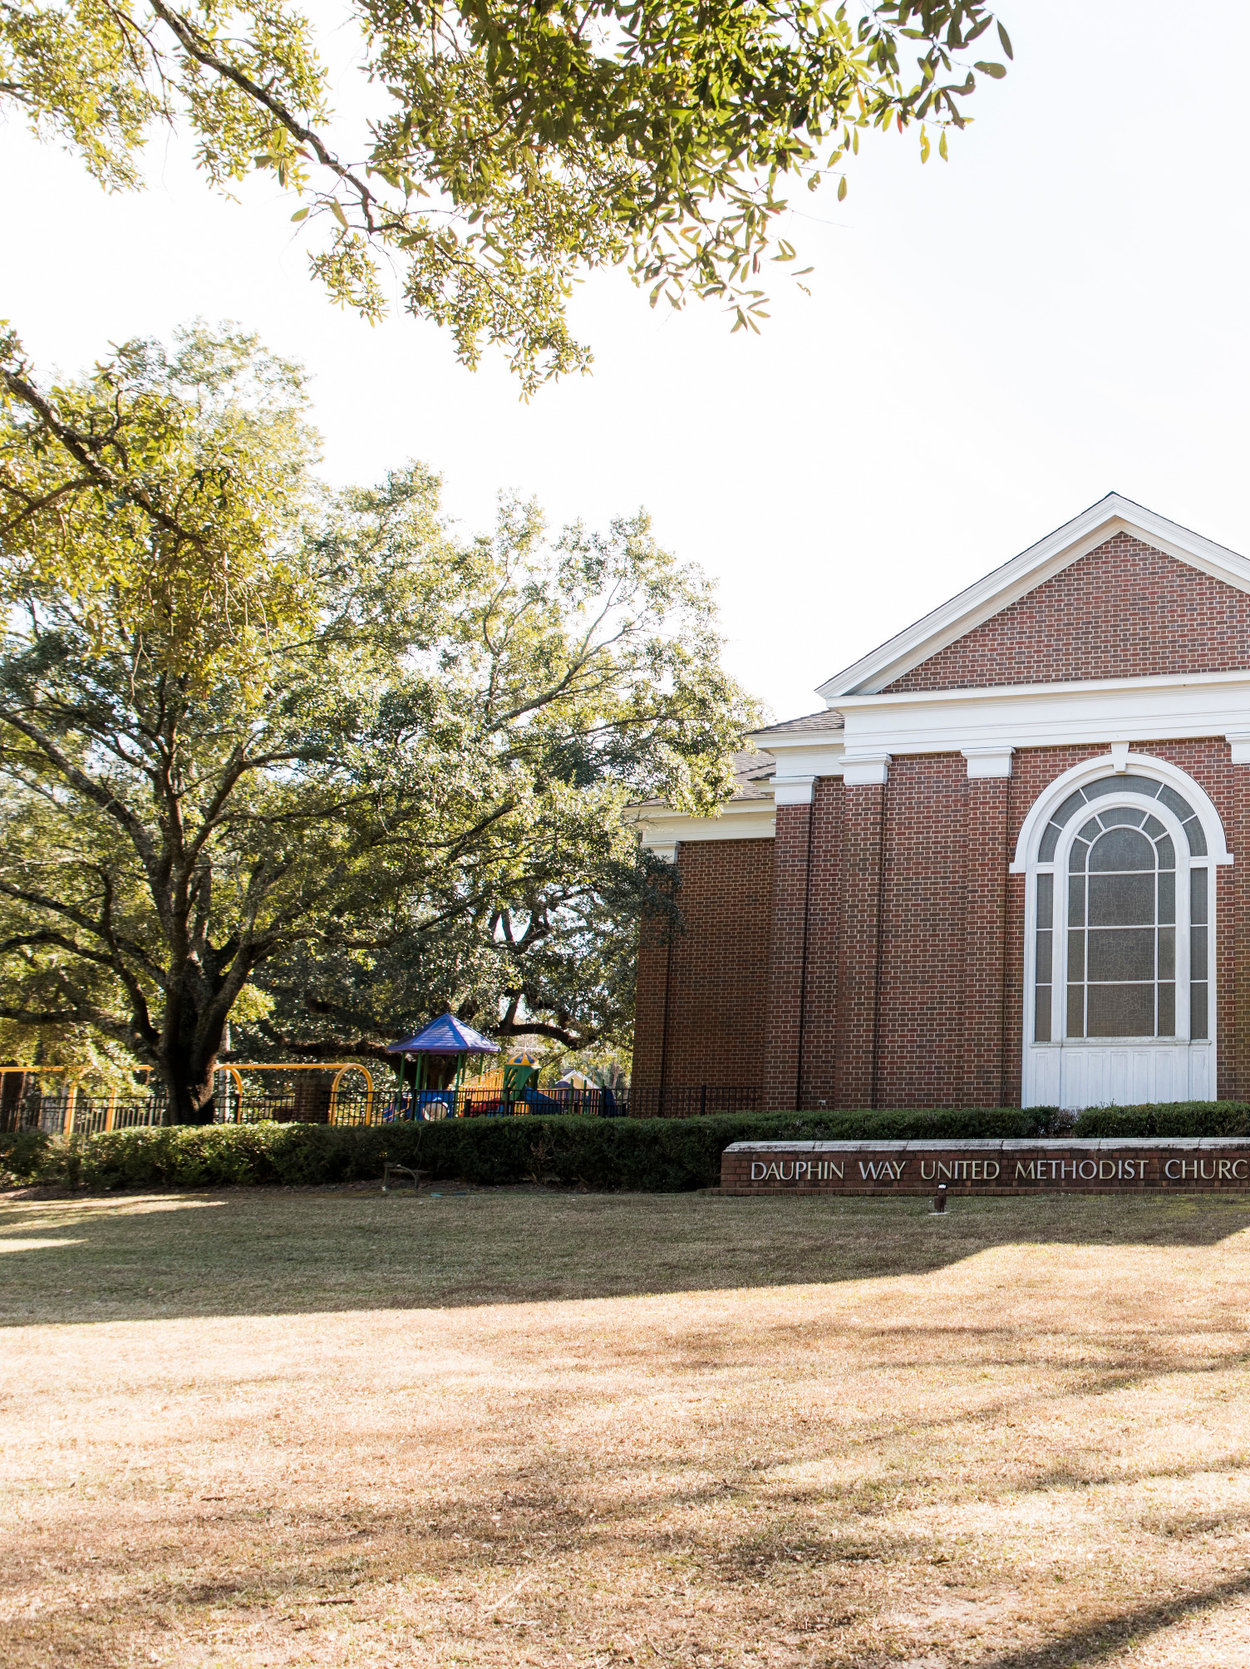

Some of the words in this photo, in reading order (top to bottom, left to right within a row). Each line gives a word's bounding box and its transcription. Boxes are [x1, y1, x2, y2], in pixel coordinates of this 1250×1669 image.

[750, 1161, 844, 1181] DAUPHIN
[858, 1160, 906, 1180] WAY
[920, 1160, 1000, 1180] UNITED
[1014, 1159, 1149, 1180] METHODIST
